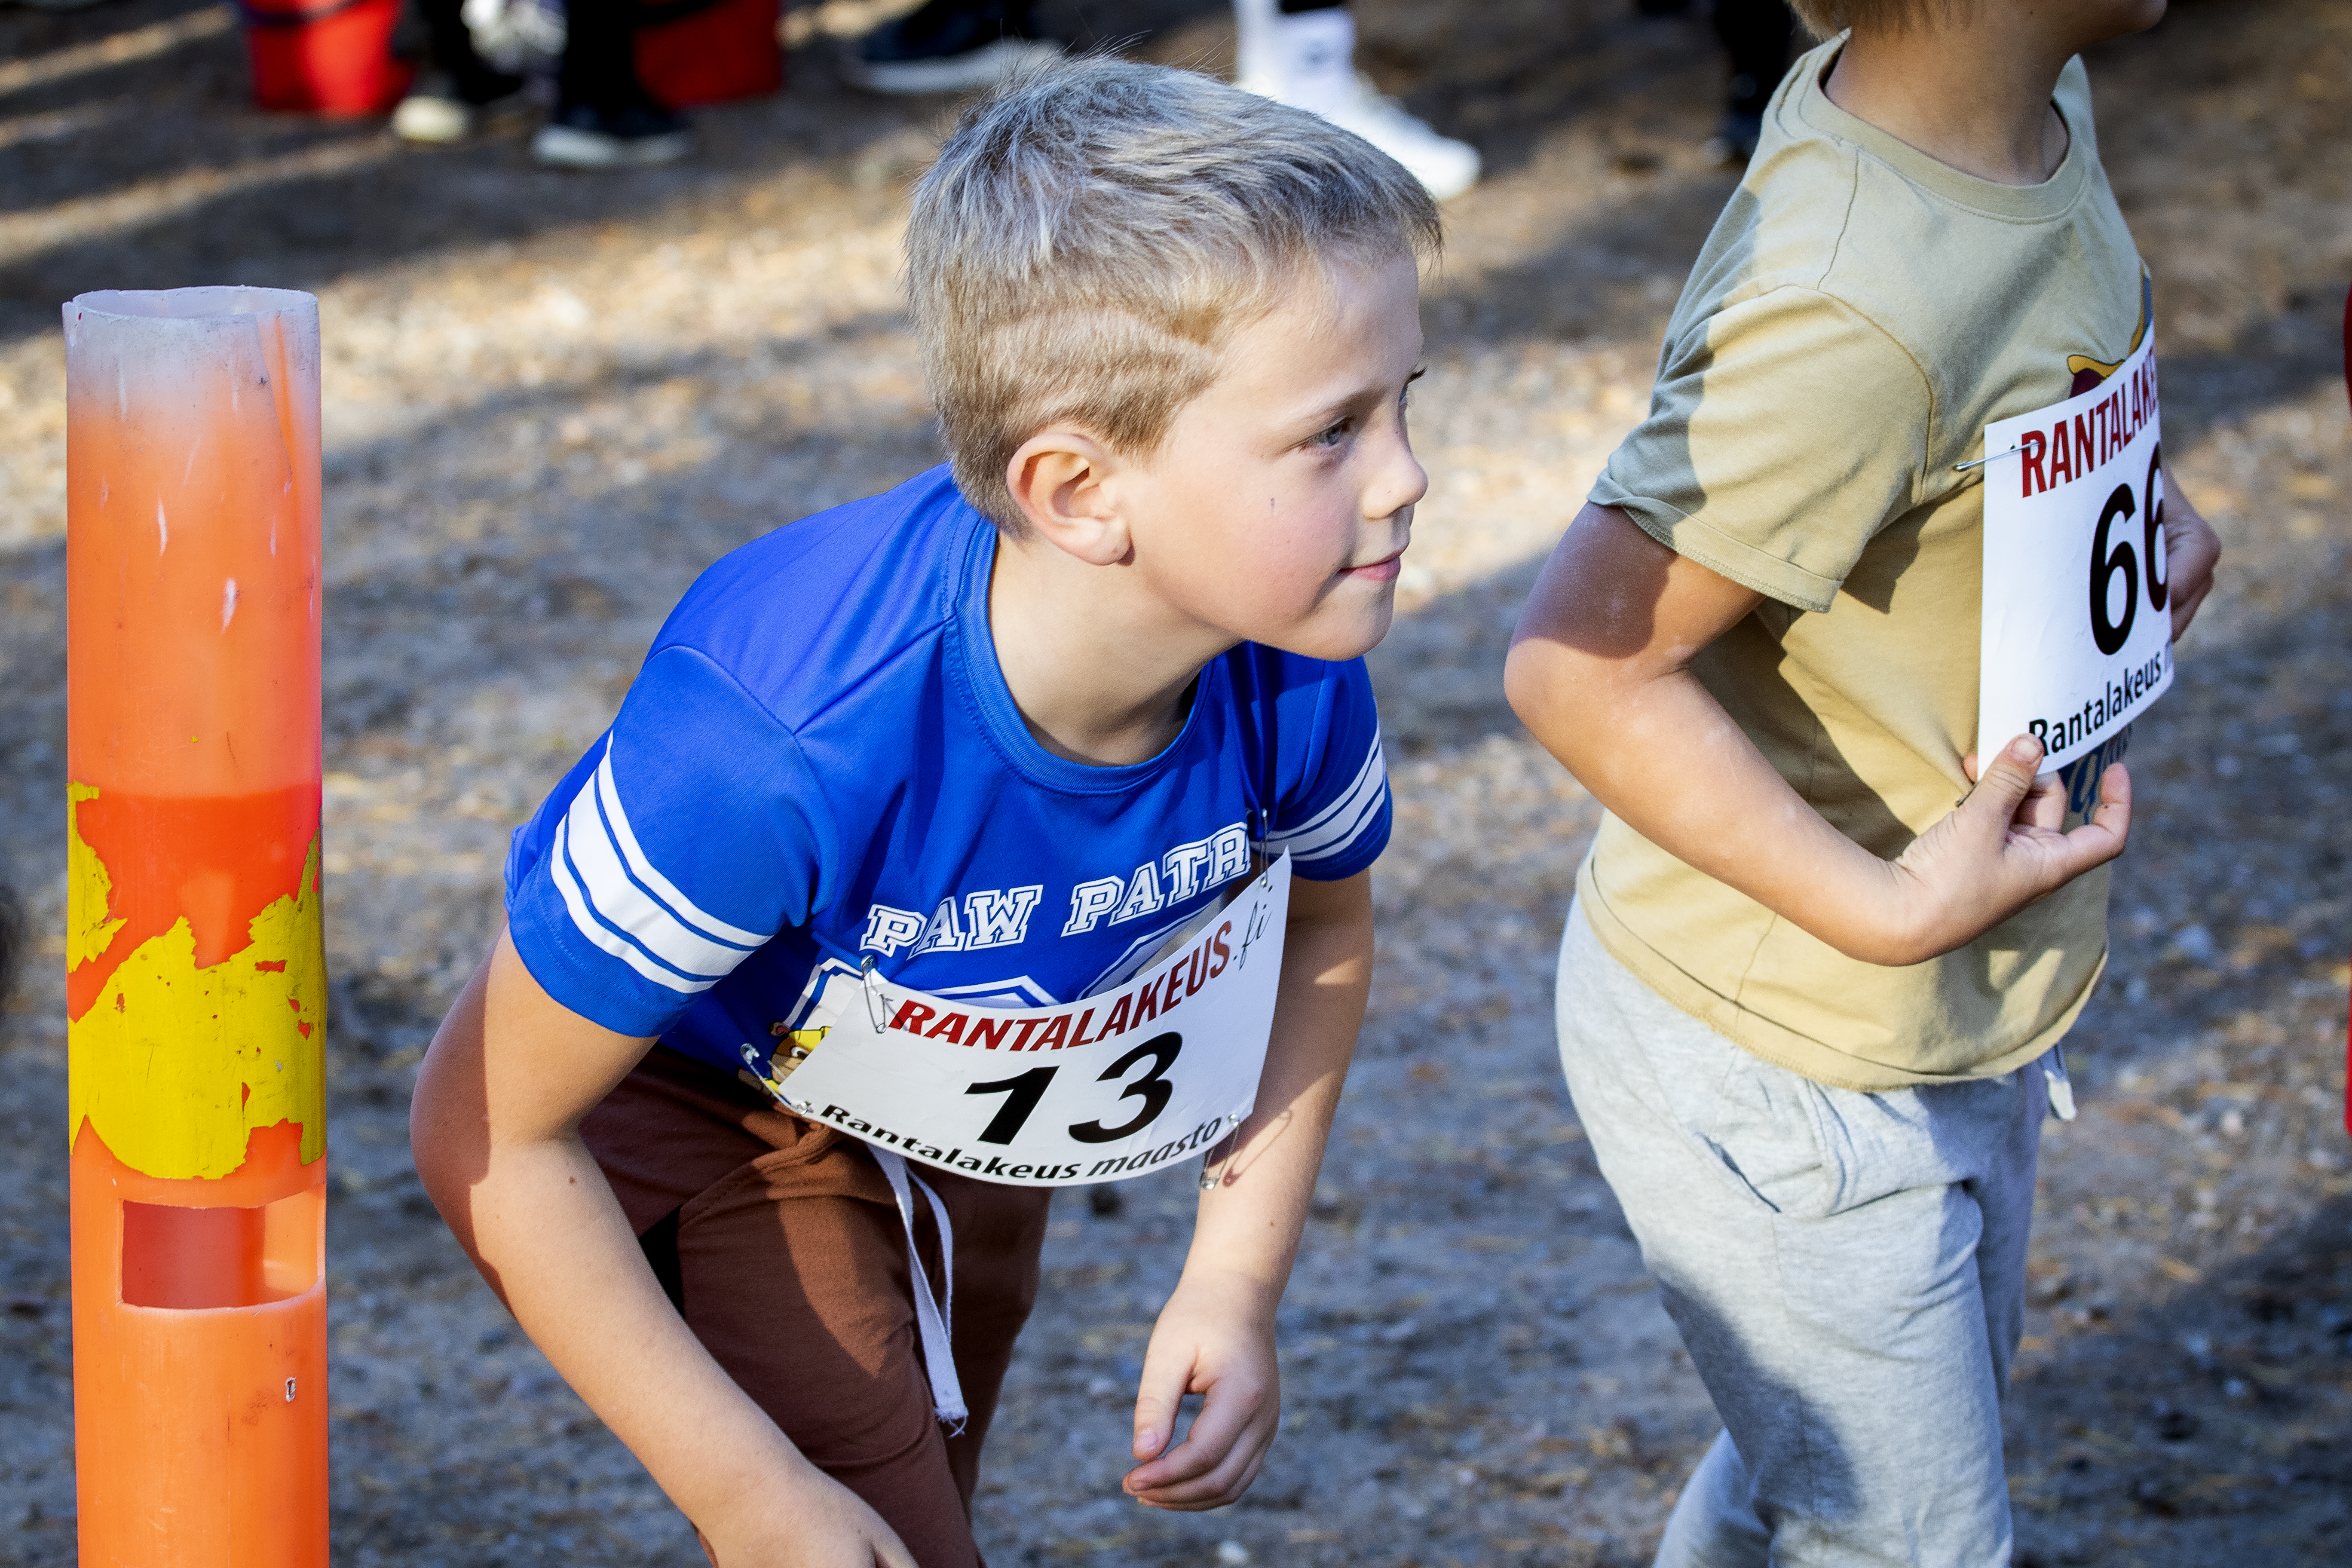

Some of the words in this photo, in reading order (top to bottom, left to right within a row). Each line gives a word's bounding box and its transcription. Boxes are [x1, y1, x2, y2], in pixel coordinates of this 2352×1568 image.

[2029, 651, 2161, 757] Rantalakeus
[860, 884, 1044, 961] PAW
[1060, 821, 1251, 937] PATR
[820, 1103, 1082, 1179] Rantalakeus
[1086, 1117, 1222, 1177] maasto
[963, 1031, 1183, 1145] 13
